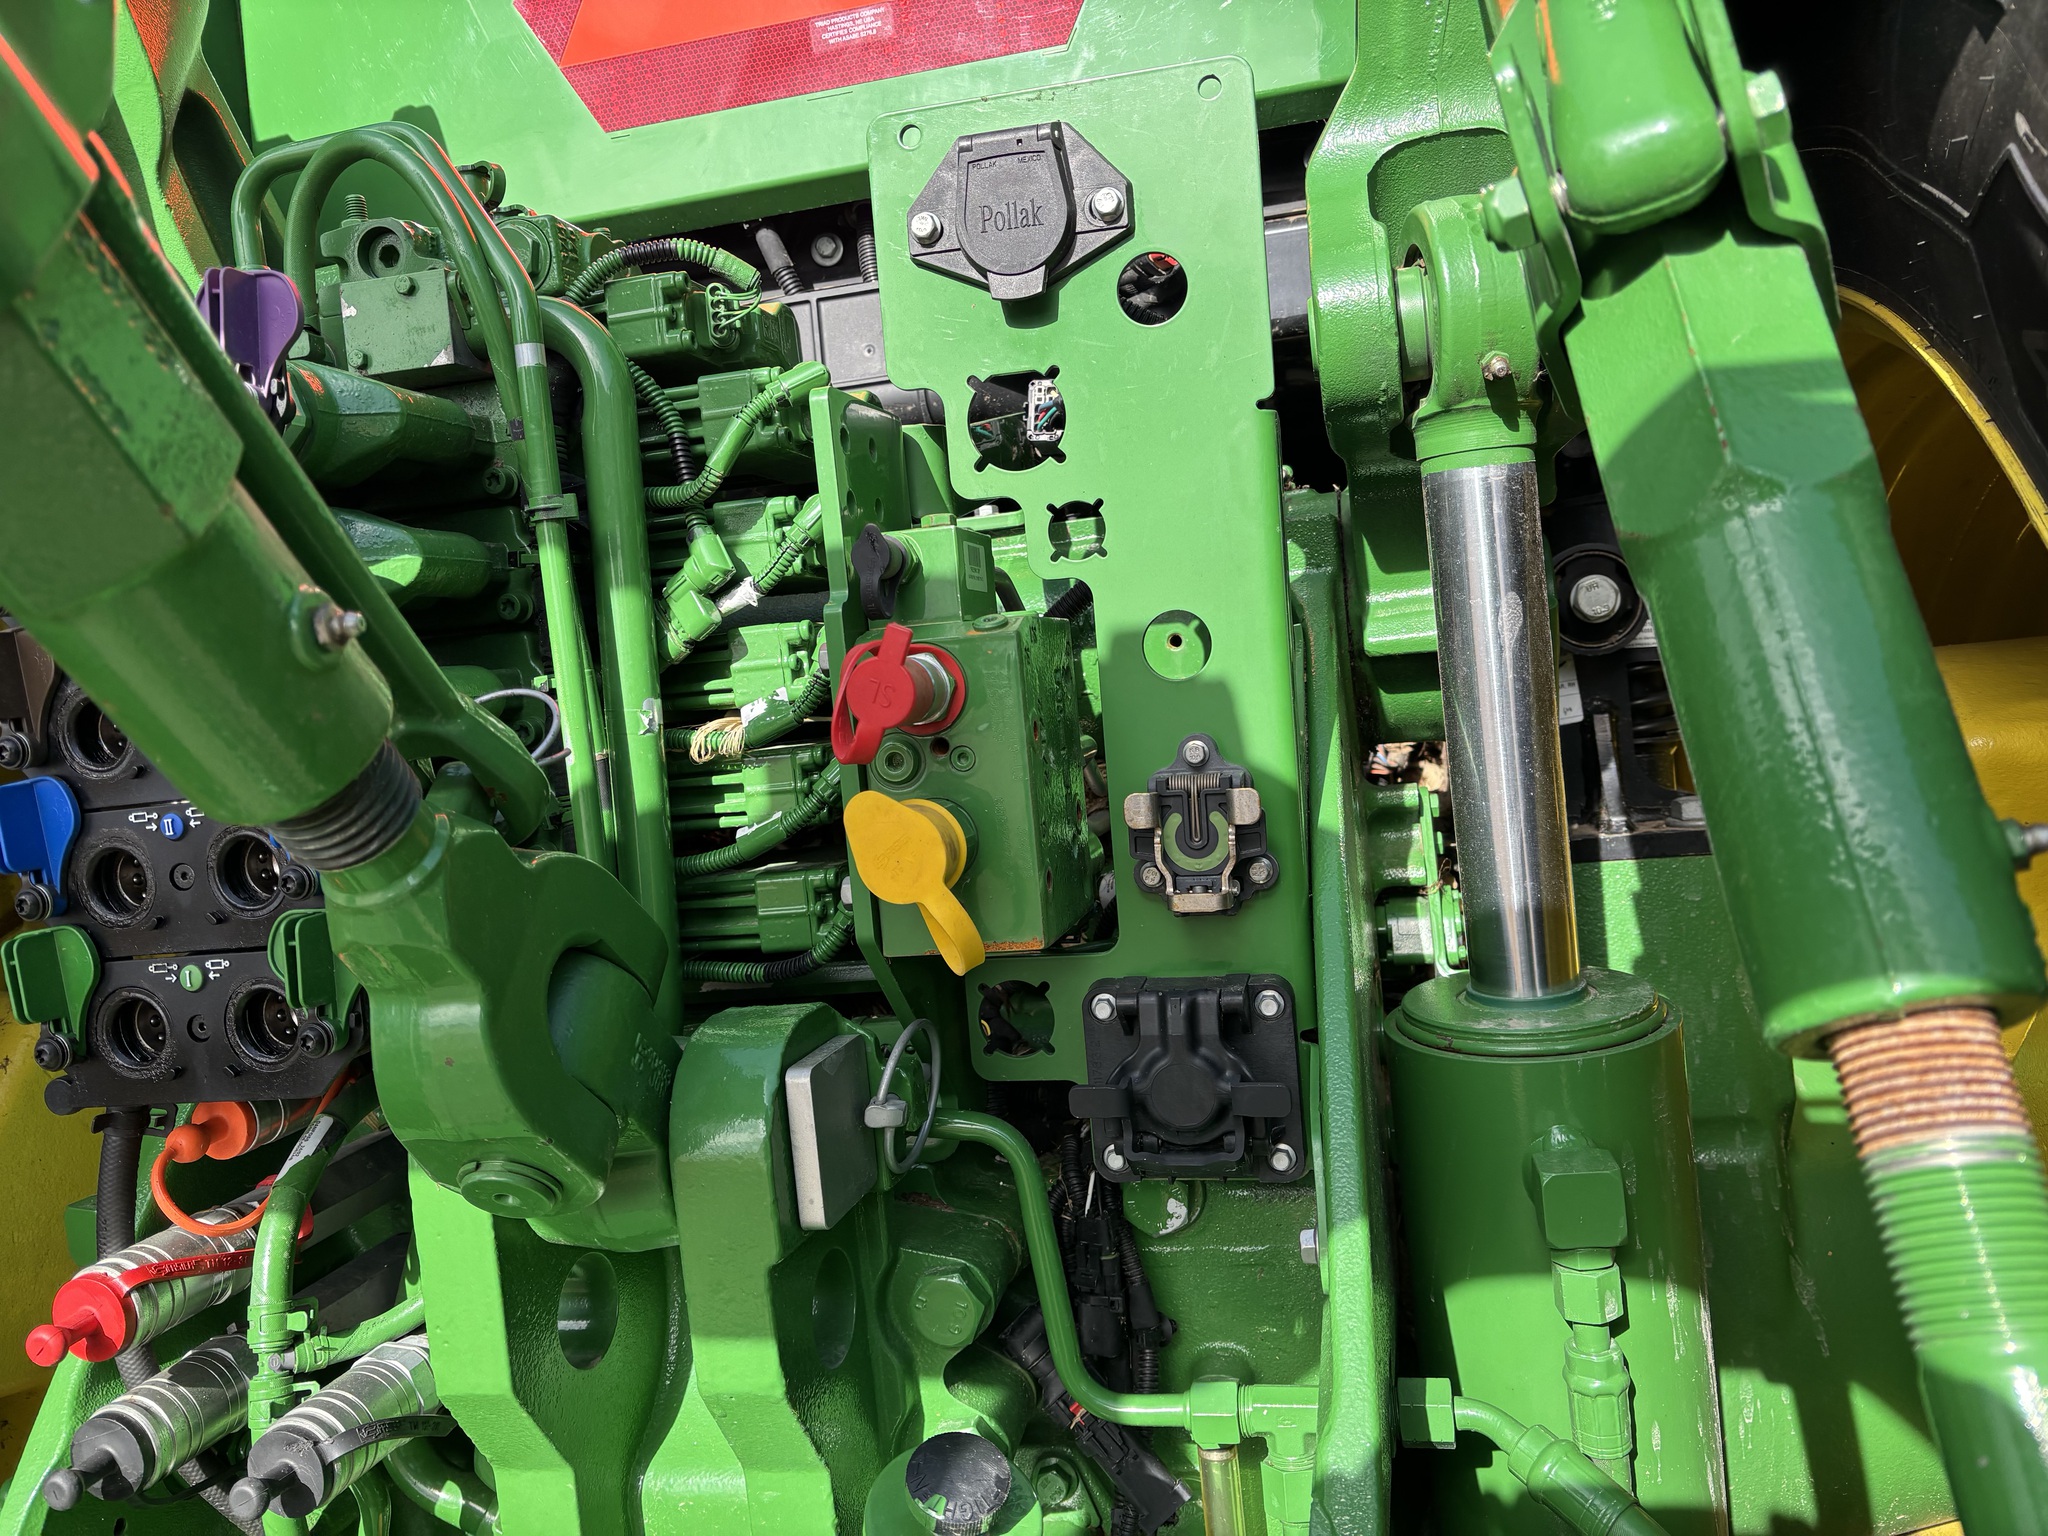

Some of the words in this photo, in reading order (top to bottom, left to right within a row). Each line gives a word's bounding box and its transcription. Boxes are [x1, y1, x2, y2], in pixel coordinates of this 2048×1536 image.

[815, 20, 830, 28] TRIAD
[831, 13, 859, 24] PRODUCTS
[860, 7, 884, 17] COMPANY
[822, 29, 848, 39] CERTIFIES
[849, 21, 881, 33] COMPLIANCE
[972, 161, 997, 170] POLLAK
[1017, 154, 1041, 164] MEXICO
[978, 198, 1044, 233] Pollak
